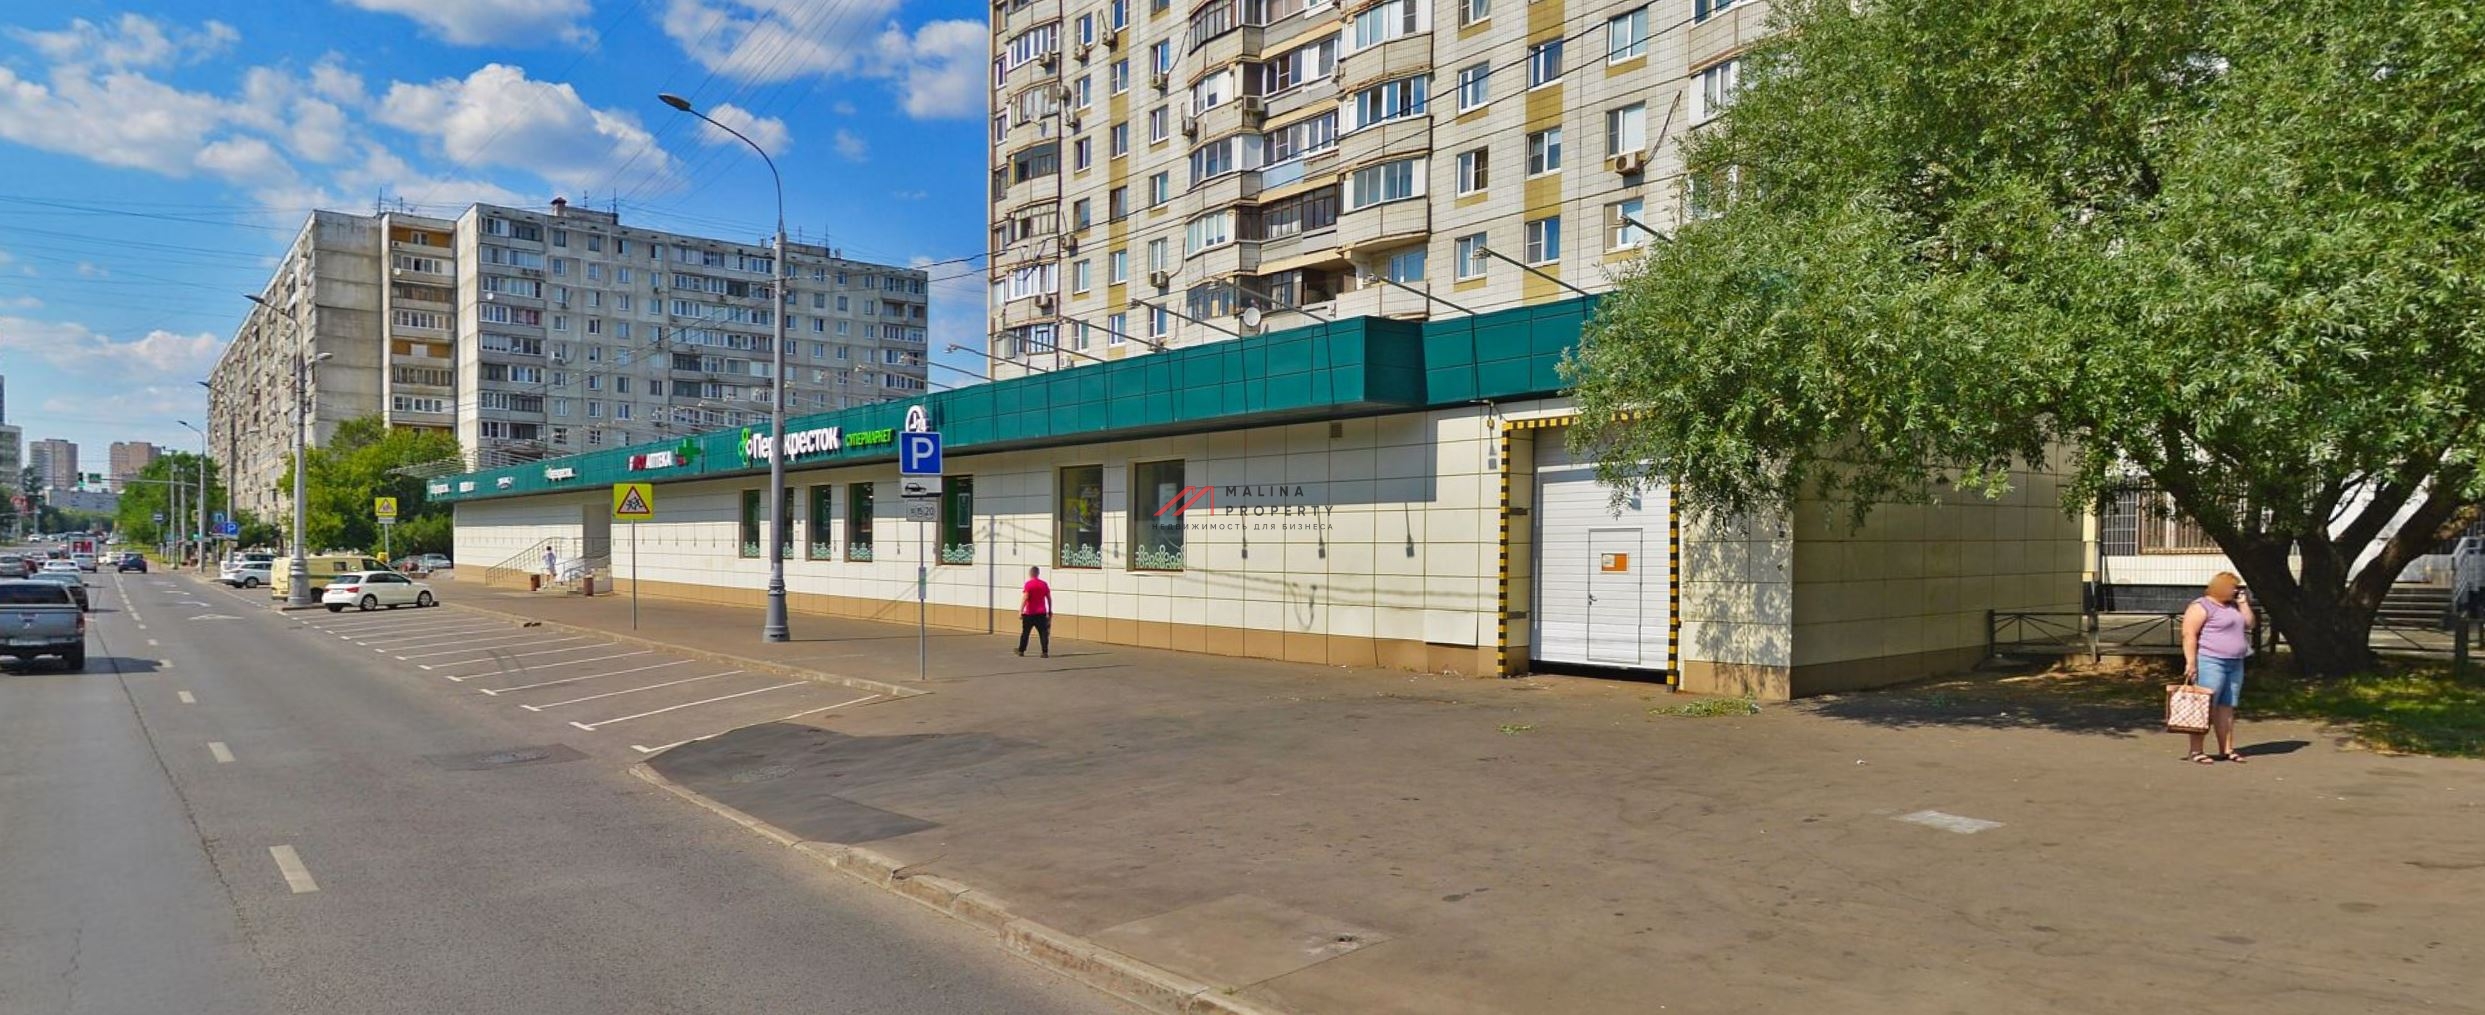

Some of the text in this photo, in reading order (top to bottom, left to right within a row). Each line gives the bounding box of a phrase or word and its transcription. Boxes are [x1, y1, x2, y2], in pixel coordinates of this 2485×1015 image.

[753, 427, 839, 463] Перкресток
[846, 429, 893, 447] СУПЕРМАРКЕТ
[912, 437, 934, 469] P
